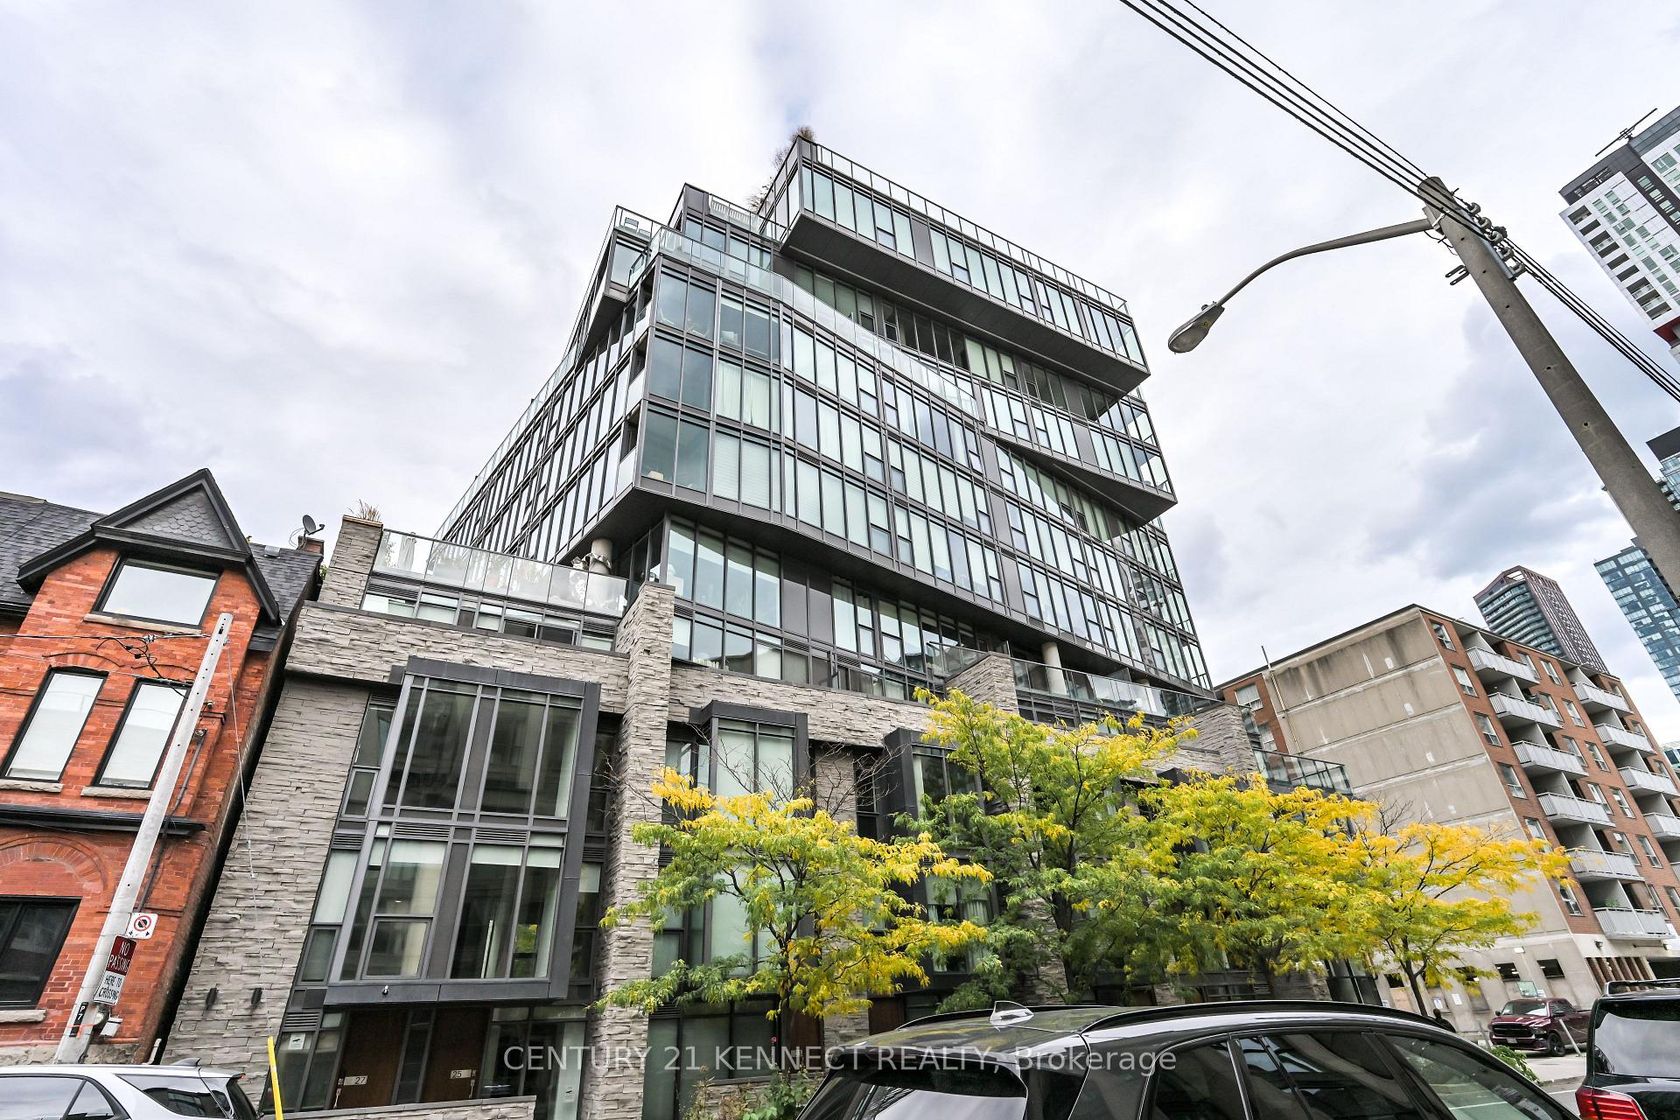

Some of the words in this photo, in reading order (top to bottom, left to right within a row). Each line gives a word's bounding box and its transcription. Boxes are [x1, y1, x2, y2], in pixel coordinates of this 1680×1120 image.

[120, 941, 130, 956] NO
[108, 954, 130, 972] PASSING
[104, 975, 116, 986] HERE
[116, 977, 123, 988] TO
[98, 987, 119, 1000] CROSSING
[355, 1077, 366, 1085] 27
[451, 1070, 462, 1079] 25
